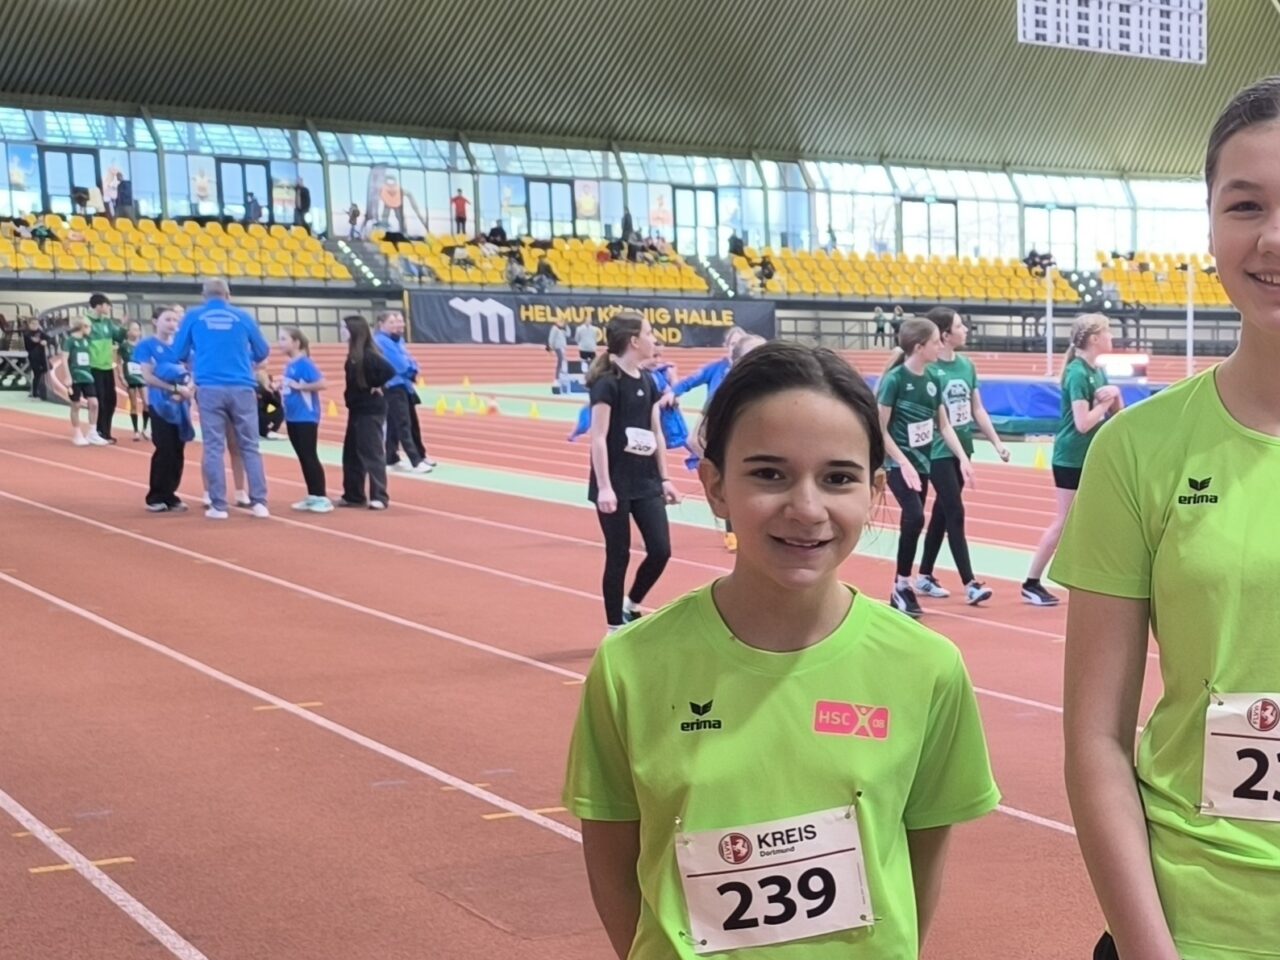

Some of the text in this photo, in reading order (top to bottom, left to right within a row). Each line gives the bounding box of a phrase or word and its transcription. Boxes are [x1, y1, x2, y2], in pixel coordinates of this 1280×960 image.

[520, 304, 595, 323] HELMUT
[674, 308, 734, 326] HALLE
[1178, 493, 1218, 505] erima
[680, 718, 722, 732] erima
[818, 710, 885, 729] HSC 08
[757, 824, 817, 849] KREIS
[759, 846, 795, 857] Dortmund
[716, 867, 837, 931] 239
